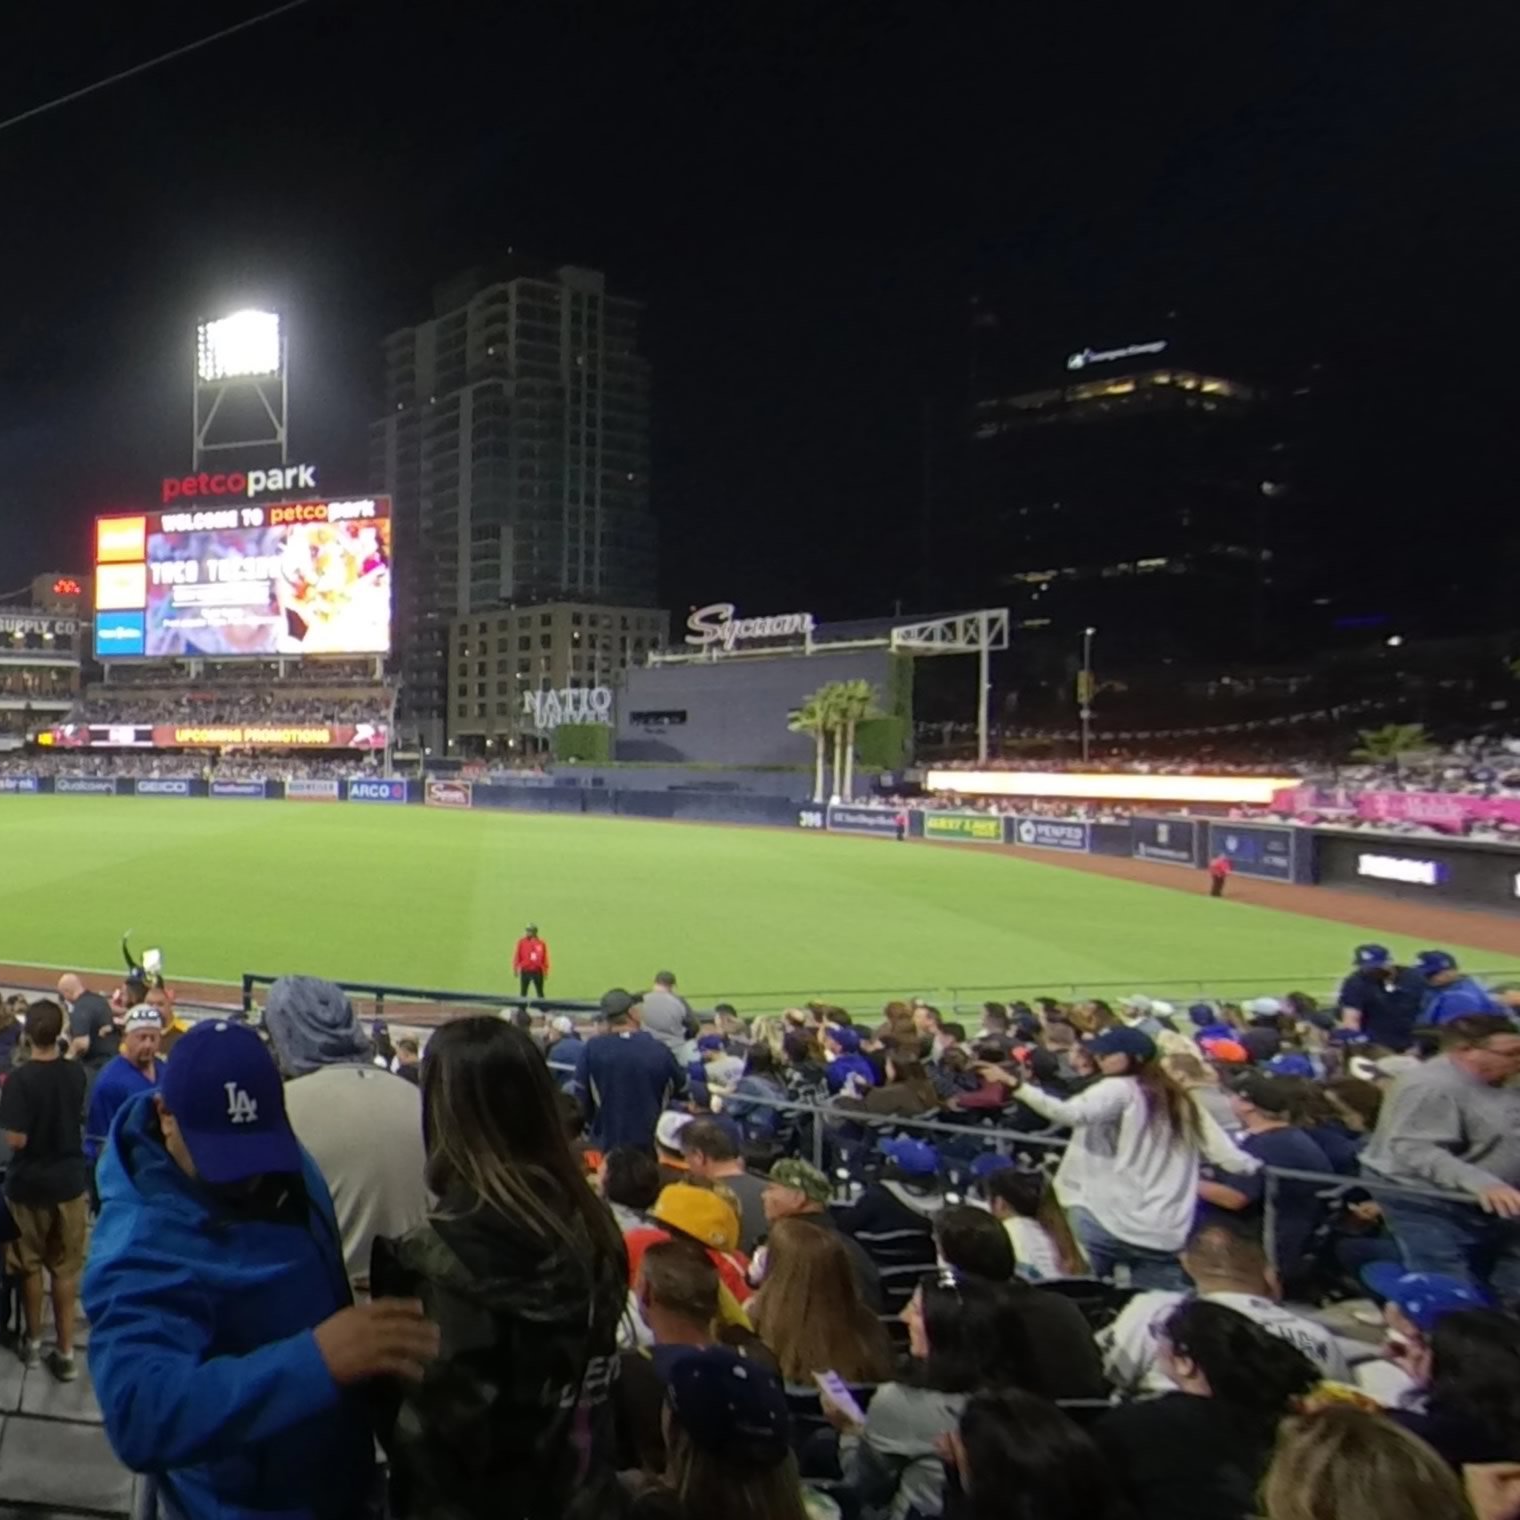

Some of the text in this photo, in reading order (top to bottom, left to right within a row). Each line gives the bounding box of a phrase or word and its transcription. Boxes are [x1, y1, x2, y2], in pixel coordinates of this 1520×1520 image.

[161, 463, 317, 502] petcopark
[685, 603, 815, 652] Sycuan
[175, 728, 330, 743] UPCOMING PROMOTIONS
[137, 780, 186, 794] GEICO
[350, 783, 390, 799] ARCO
[224, 1082, 257, 1123] LA
